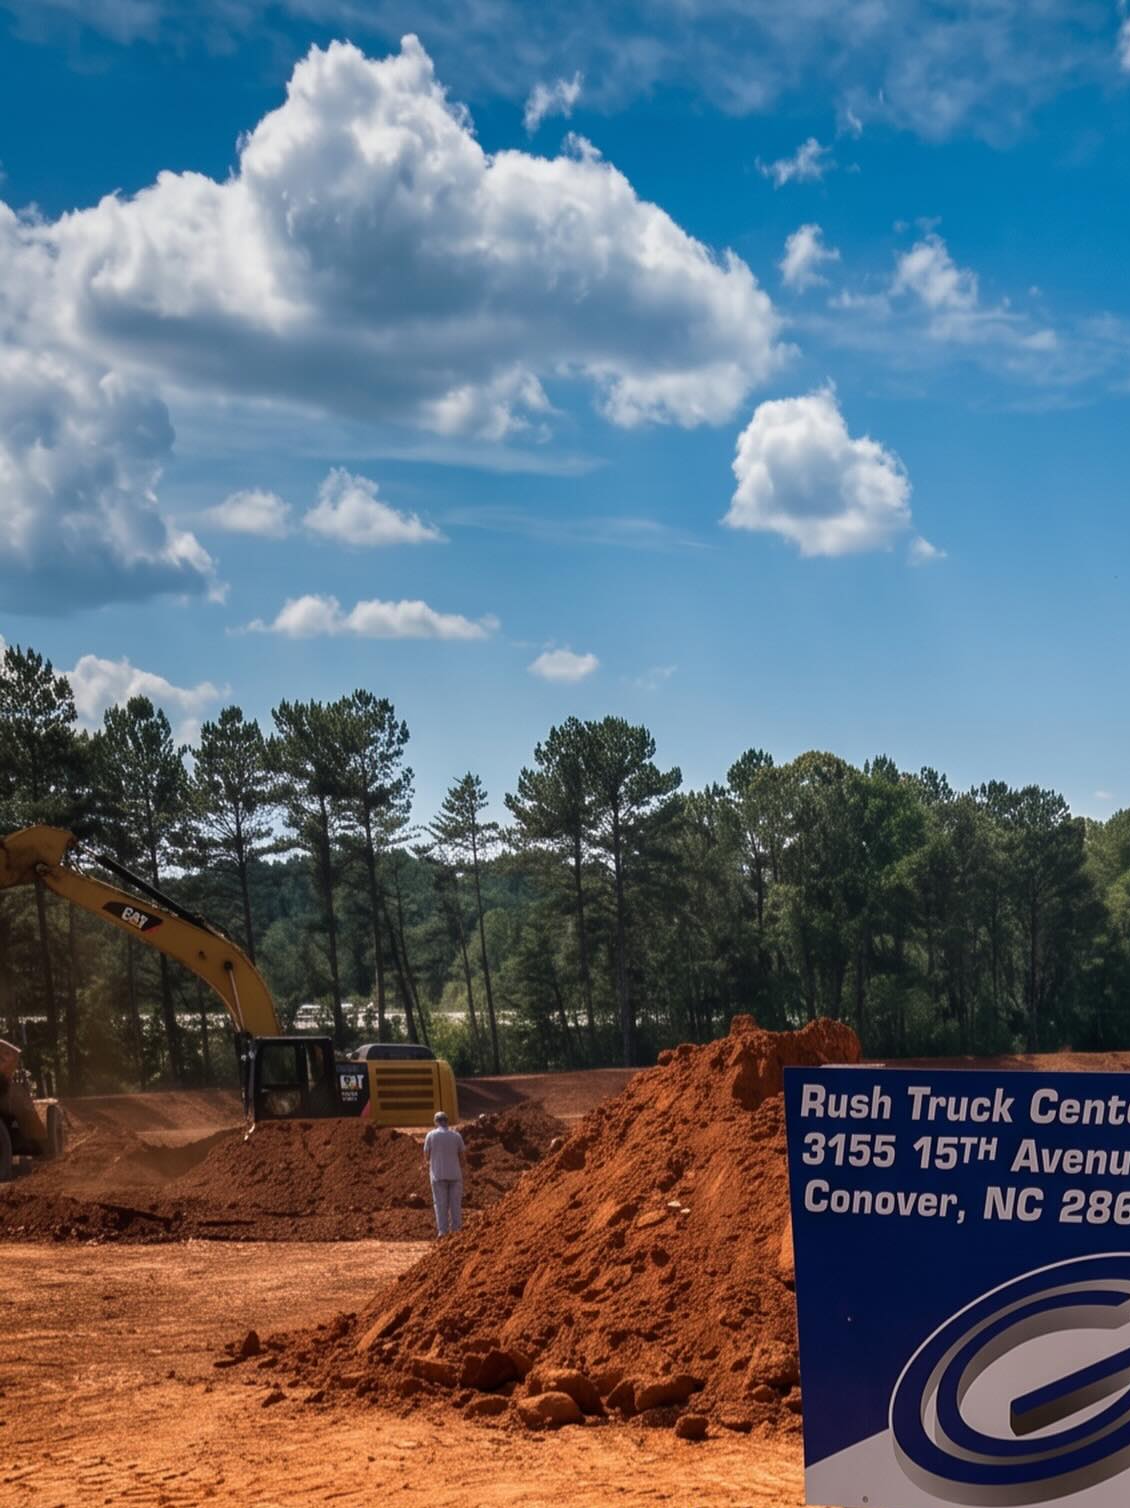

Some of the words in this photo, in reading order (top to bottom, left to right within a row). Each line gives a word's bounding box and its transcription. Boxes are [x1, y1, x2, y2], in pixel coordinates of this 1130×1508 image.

[801, 1084, 892, 1119] Rush
[907, 1086, 1015, 1123] Truck
[802, 1131, 897, 1168] 3155
[912, 1135, 999, 1170] 15TH
[804, 1179, 966, 1224] Conover,
[983, 1186, 1044, 1221] NC
